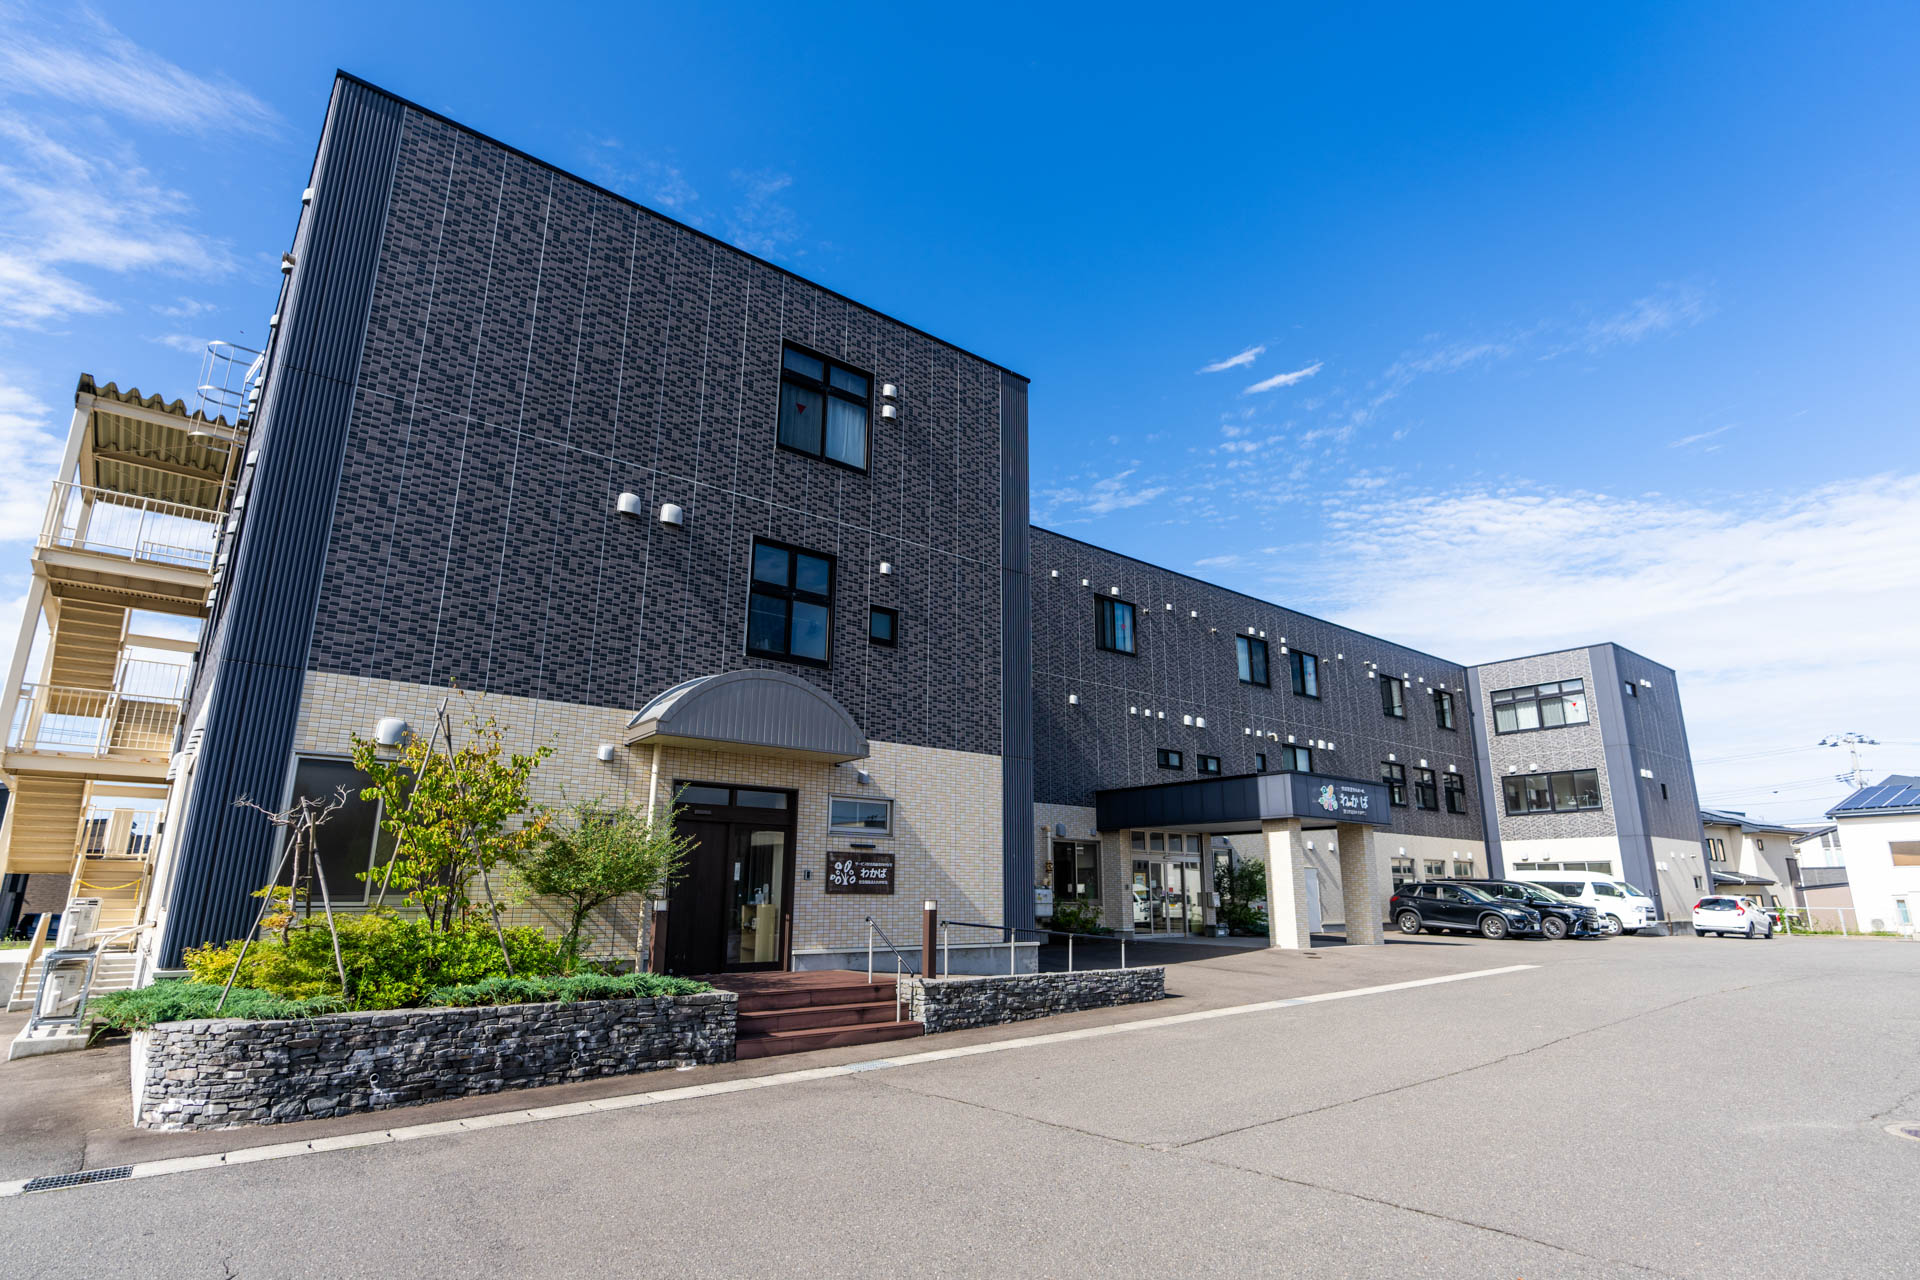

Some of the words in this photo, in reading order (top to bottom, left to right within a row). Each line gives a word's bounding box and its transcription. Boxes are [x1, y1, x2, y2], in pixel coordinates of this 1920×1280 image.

[1339, 793, 1369, 809] わかば
[860, 867, 888, 879] わかば
